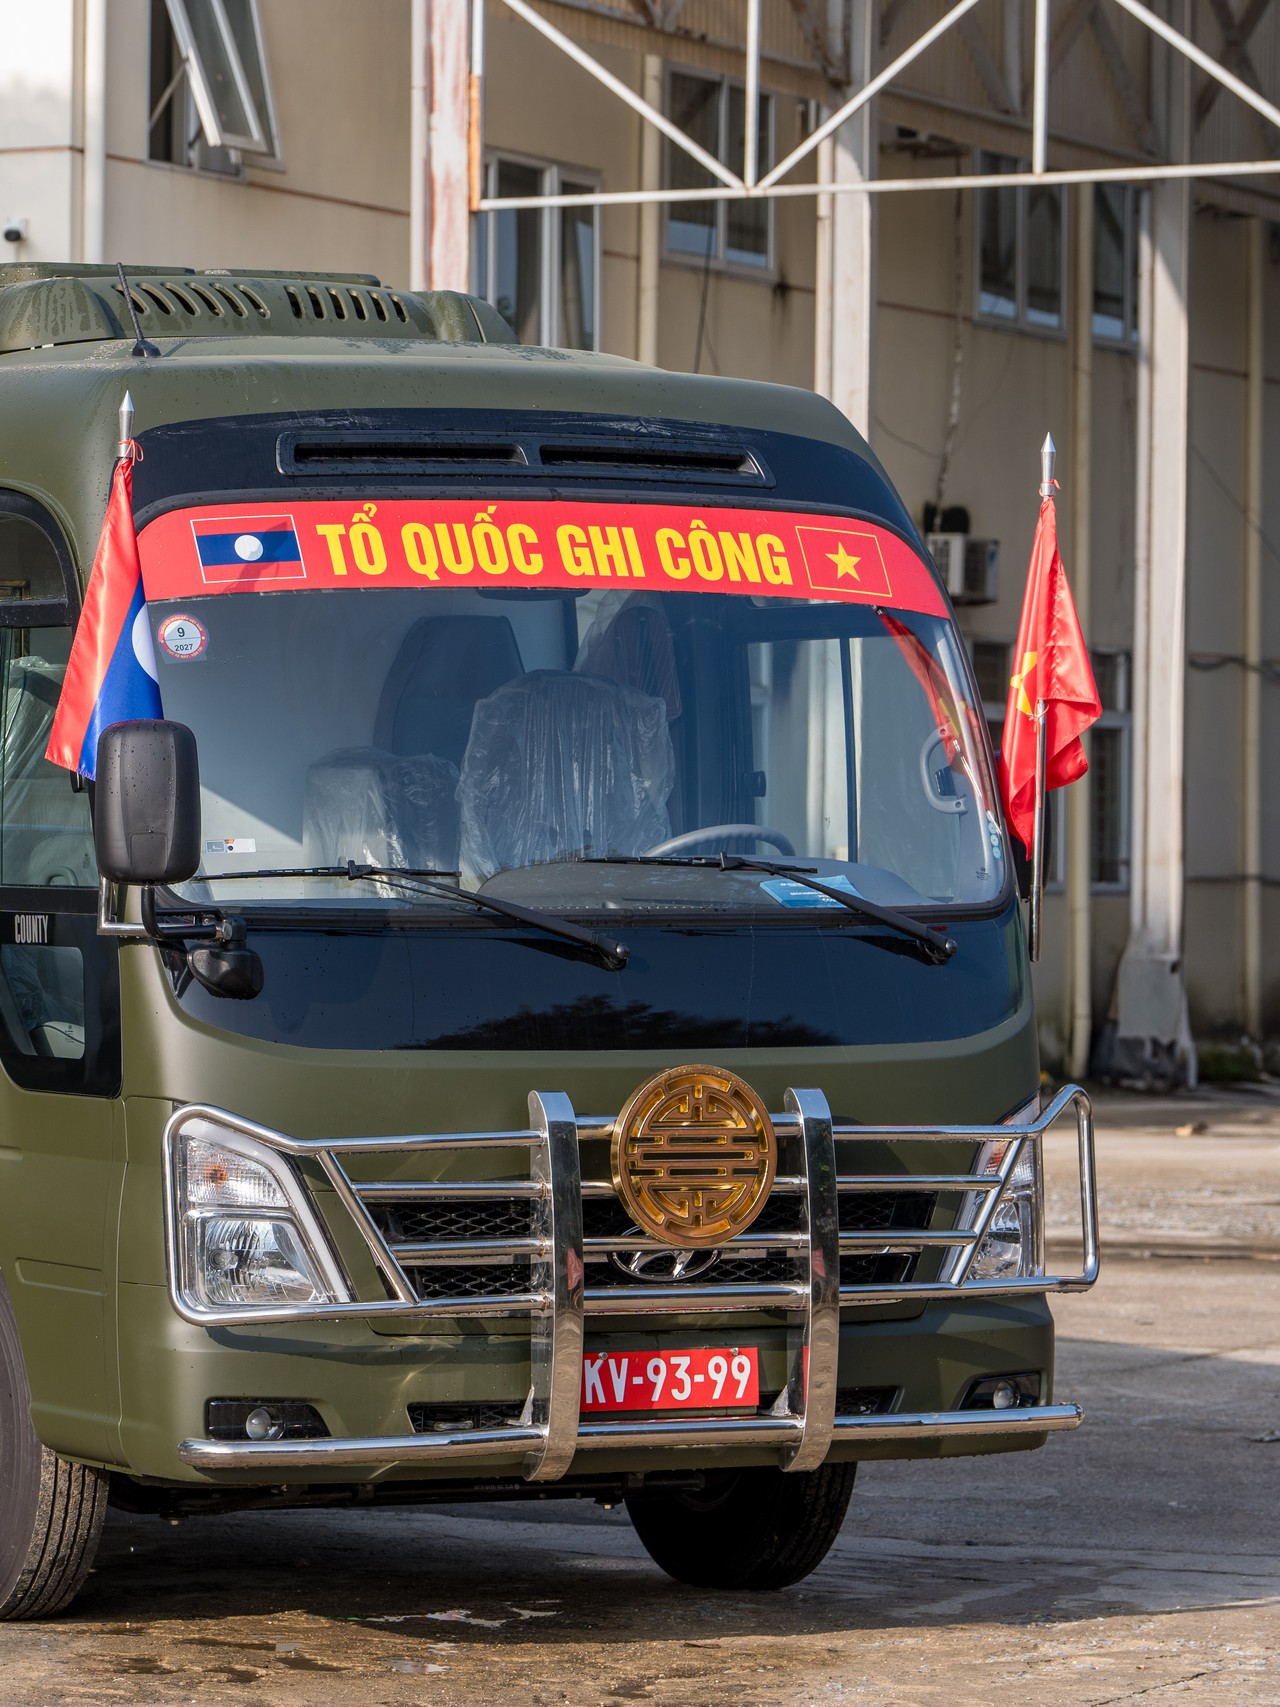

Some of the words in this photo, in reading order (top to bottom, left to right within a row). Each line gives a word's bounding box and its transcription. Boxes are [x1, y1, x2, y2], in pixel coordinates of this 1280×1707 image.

[315, 502, 388, 576] TỔ
[400, 505, 544, 581] QUỐC
[556, 524, 646, 578] GHI
[655, 519, 794, 586] CÔNG
[174, 643, 193, 651] 2027
[177, 627, 185, 637] 9
[14, 914, 49, 944] COUNTY
[584, 1355, 752, 1404] KV-93-99
